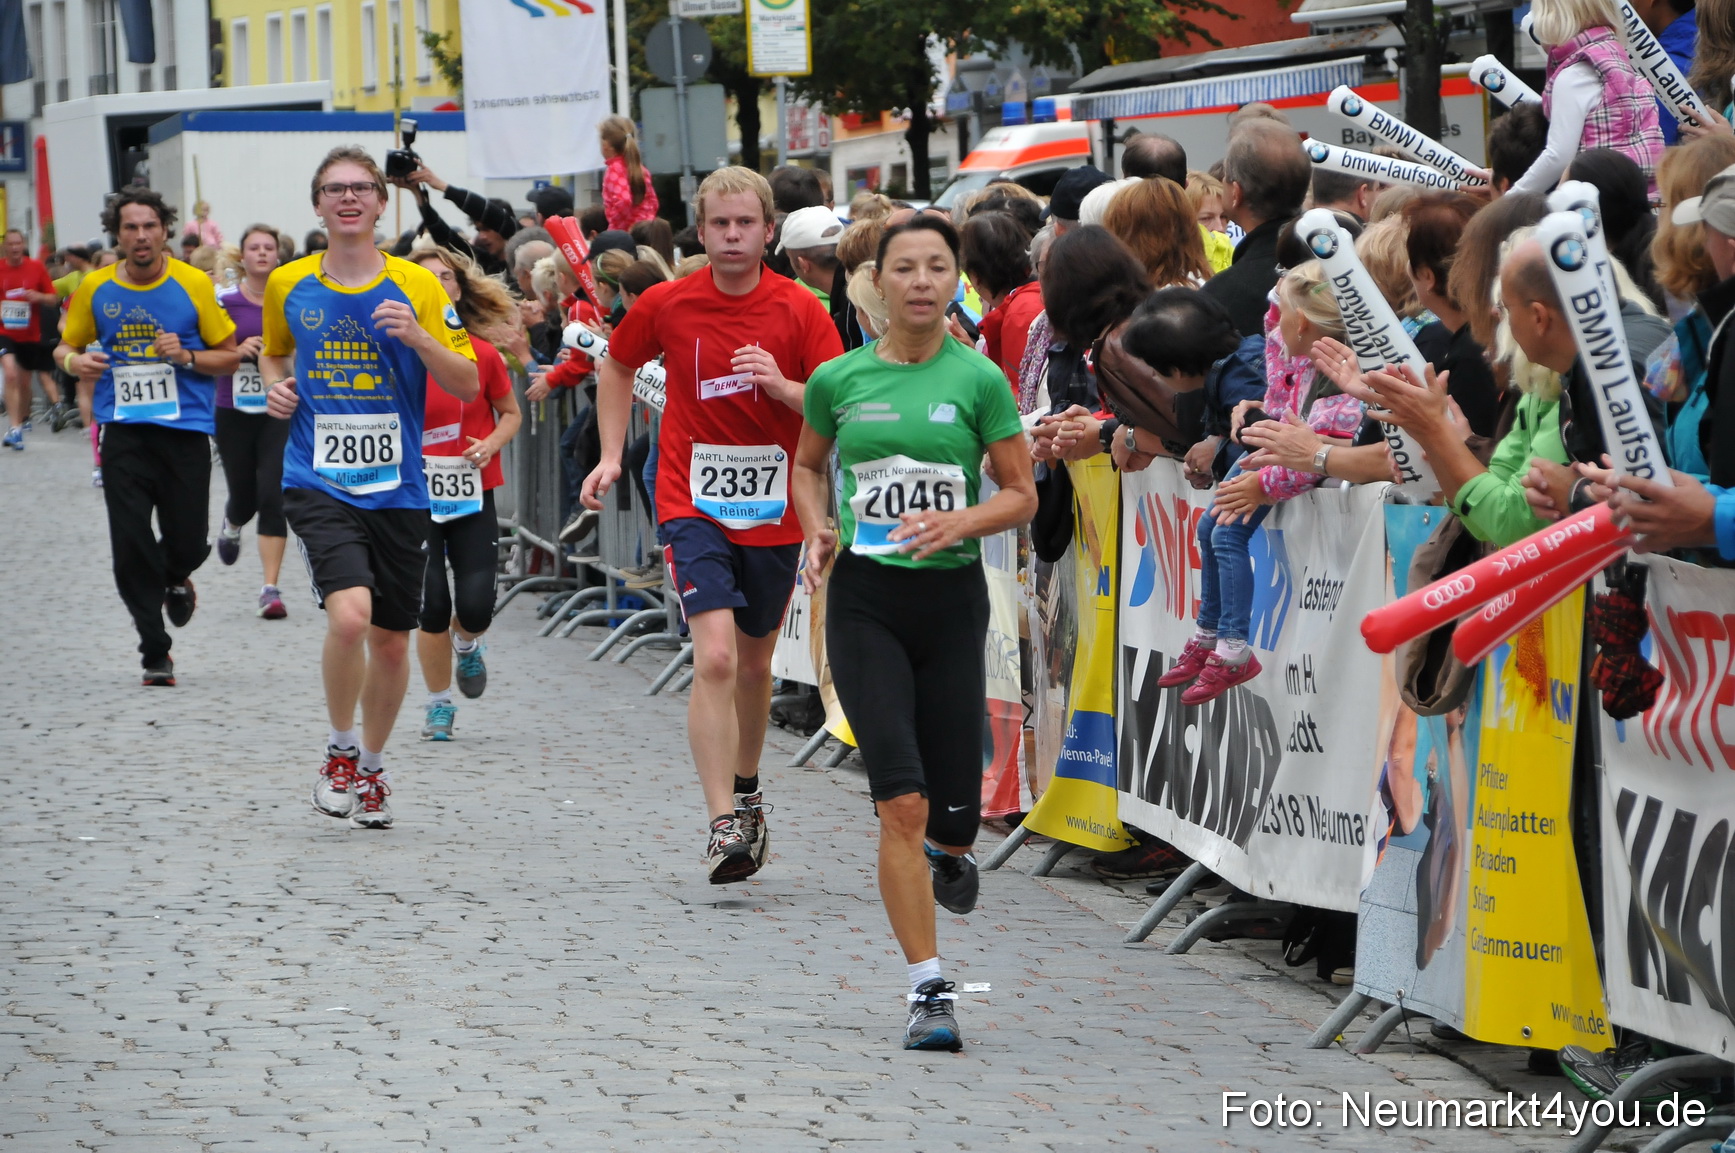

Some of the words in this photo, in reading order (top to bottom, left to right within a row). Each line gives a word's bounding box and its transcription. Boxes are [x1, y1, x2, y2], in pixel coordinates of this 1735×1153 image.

[1368, 112, 1417, 149] BMW
[1570, 287, 1627, 370] BMW
[120, 378, 169, 402] 3411
[714, 380, 738, 392] DEHN
[316, 422, 344, 431] PARTL
[345, 422, 386, 431] Neumarkt
[324, 434, 394, 464] 2808
[693, 452, 725, 462] PARTL
[726, 453, 771, 463] Neumarkt
[335, 469, 379, 484] Michael
[700, 465, 779, 498] 2337
[857, 470, 889, 483] PARTL
[432, 502, 458, 515] Birgit
[719, 504, 760, 518] Reiner
[865, 480, 955, 519] 2046
[1542, 515, 1596, 551] Audi
[1491, 548, 1541, 576] BKK
[1065, 814, 1118, 841] www.kann.de
